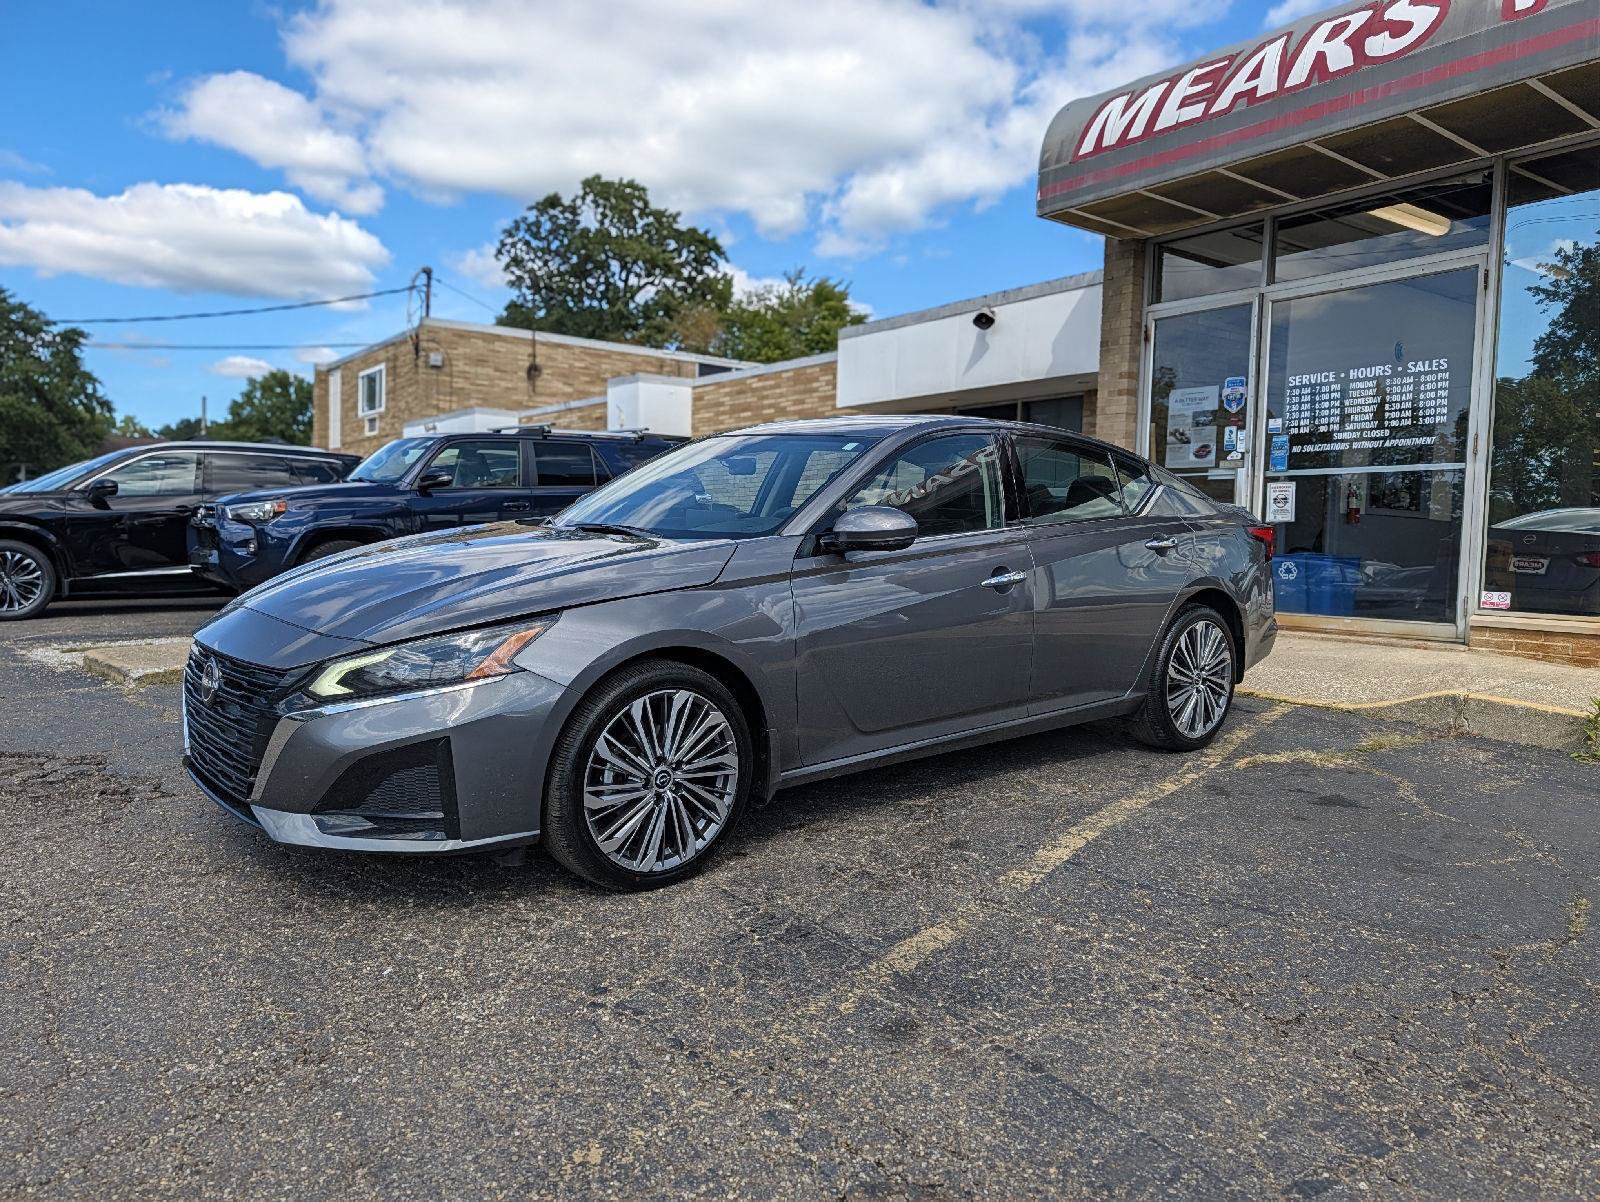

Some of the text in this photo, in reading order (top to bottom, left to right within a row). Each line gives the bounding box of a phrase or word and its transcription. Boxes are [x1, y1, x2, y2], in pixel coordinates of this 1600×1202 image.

[1075, 0, 1445, 160] MEARS
[1286, 388, 1300, 396] 7:30
[1301, 386, 1311, 395] AM
[1330, 383, 1341, 392] PM
[1350, 380, 1377, 390] MONDAY
[1386, 377, 1401, 386] 8:30
[1402, 375, 1414, 384] AM
[1420, 373, 1437, 382] 8:00
[1437, 371, 1450, 380] PM
[1288, 358, 1448, 387] SERVICE HOURS SALES
[1286, 396, 1300, 404] 7:30
[1301, 394, 1311, 402] AM
[1315, 392, 1330, 401] 6:00
[1330, 391, 1341, 400] PM
[1349, 388, 1377, 398] TUESDAY
[1386, 385, 1401, 394] 9:00
[1402, 383, 1414, 392] AM
[1420, 381, 1437, 391] 6:00
[1437, 380, 1450, 389] PM
[1286, 403, 1300, 412] 7:30
[1300, 402, 1311, 411] AM
[1315, 401, 1330, 409] 6:00
[1330, 399, 1341, 408] PM
[1343, 396, 1382, 407] WEDNESDAY
[1386, 394, 1401, 402] 9:00
[1401, 392, 1413, 401] AM
[1419, 391, 1436, 400] 6:00
[1437, 389, 1449, 398] PM
[1285, 411, 1300, 420] 7:30
[1300, 410, 1311, 418] AM
[1315, 409, 1330, 417] 7:00
[1330, 407, 1341, 416] PM
[1344, 404, 1378, 415] THURSDAY
[1384, 402, 1400, 411] 8:30
[1400, 401, 1412, 409] AM
[1418, 399, 1436, 408] 8:00
[1436, 398, 1448, 406] PM
[1285, 419, 1299, 428] 7:30
[1299, 418, 1310, 426] AM
[1314, 416, 1329, 425] 6:00
[1329, 415, 1340, 424] PM
[1350, 412, 1374, 422] FRIDAY
[1384, 410, 1400, 419] 9:00
[1400, 409, 1412, 417] AM
[1418, 407, 1436, 416] 6:00
[1436, 406, 1448, 415] PM
[1299, 425, 1310, 434] AM
[1329, 423, 1340, 432] PM
[1344, 420, 1379, 431] SATURDAY
[1384, 419, 1400, 428] 9:00
[1400, 418, 1412, 427] AM
[1418, 416, 1435, 425] 3:00
[1435, 415, 1447, 424] PM
[1333, 429, 1390, 440] SUNDAY CLOSED
[1291, 445, 1302, 453] NO
[1302, 442, 1350, 453] SOLICITATIONS
[1352, 440, 1385, 449] WITHOUT
[1383, 436, 1437, 448] APPOINTMENT
